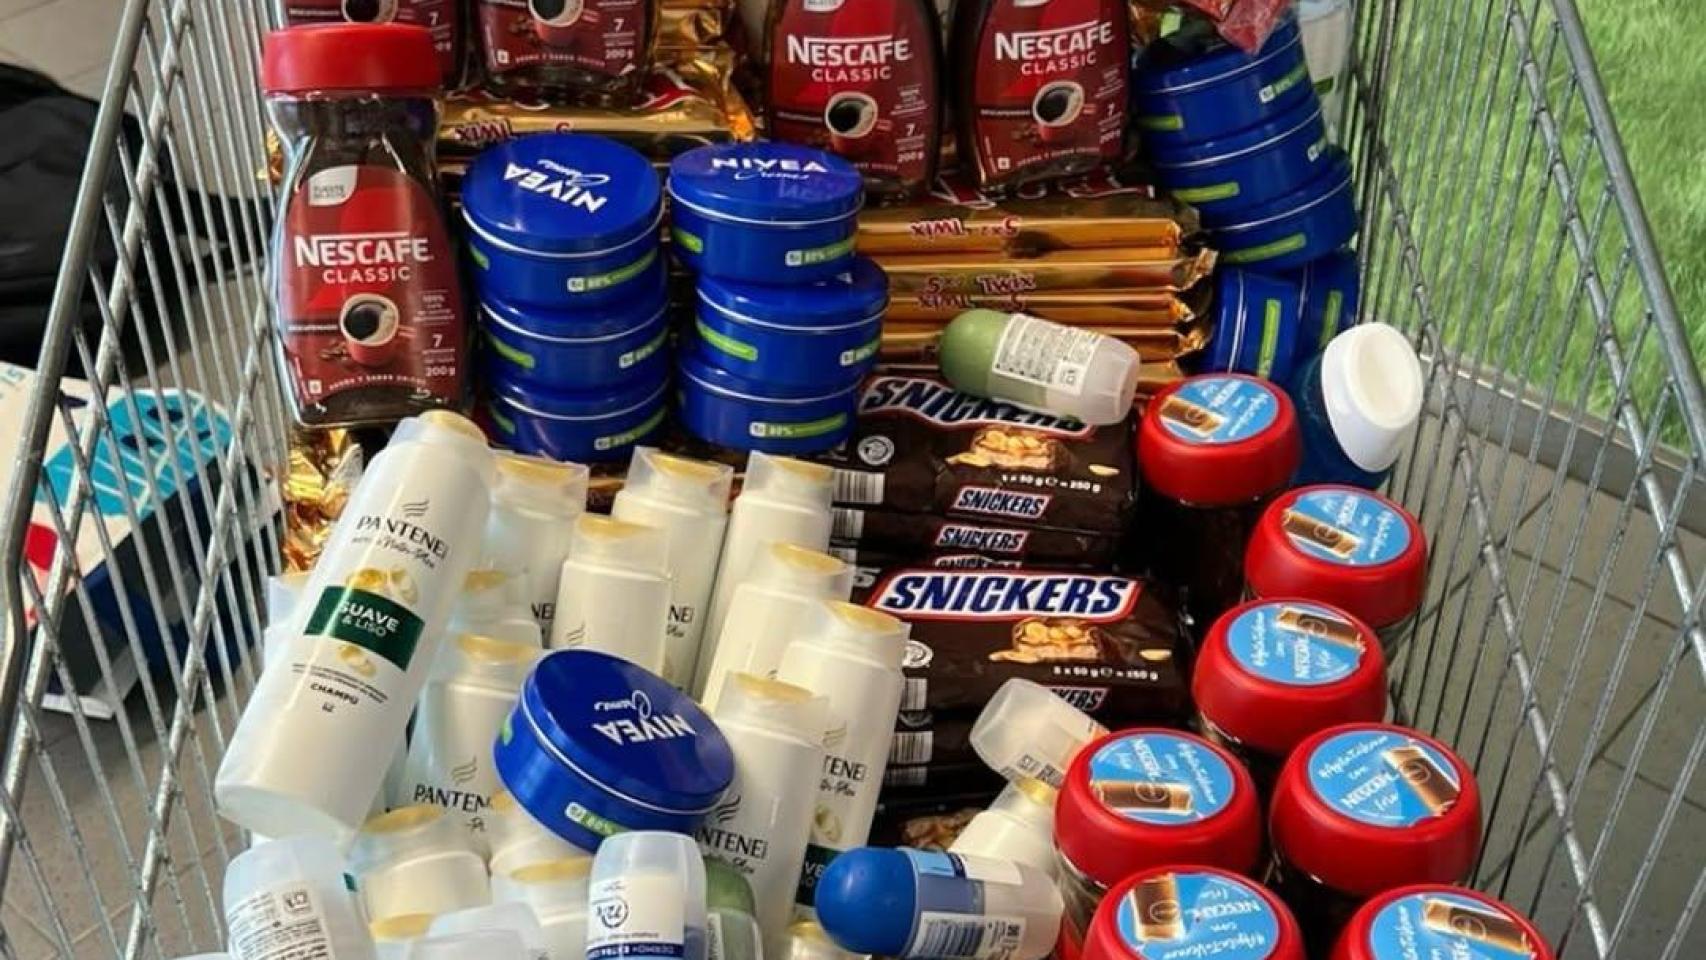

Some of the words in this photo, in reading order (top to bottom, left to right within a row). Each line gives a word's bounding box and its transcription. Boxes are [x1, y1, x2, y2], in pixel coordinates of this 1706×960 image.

[811, 66, 892, 83] CLASSIC
[1020, 52, 1097, 76] CLASSIC
[711, 157, 829, 173] NIVEA
[503, 163, 608, 214] NIVEA
[322, 266, 413, 284] CLASSIC
[432, 334, 443, 348] 7
[957, 489, 1048, 517] SNICKERS
[941, 527, 1024, 551] SNICKERS
[884, 574, 1130, 615] SNICKERS
[340, 601, 400, 633] SUAVE
[592, 713, 698, 747] NIVEA
